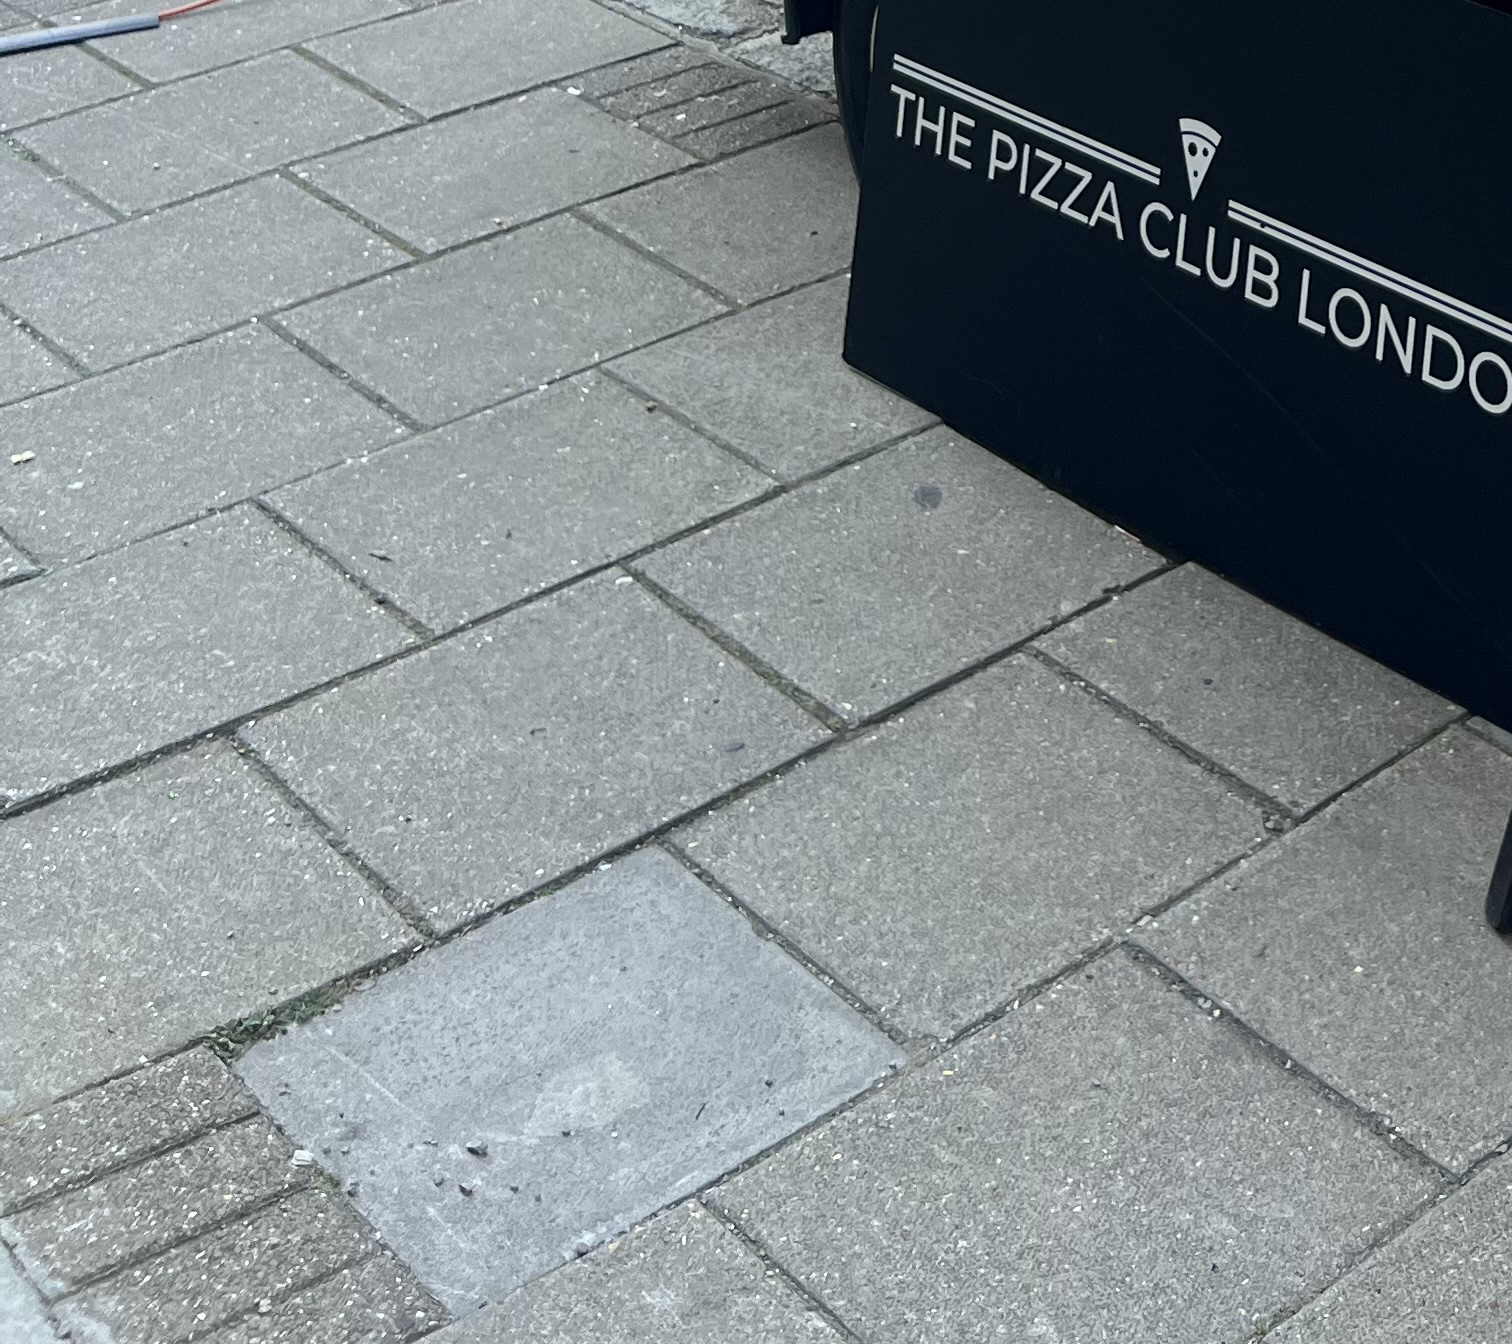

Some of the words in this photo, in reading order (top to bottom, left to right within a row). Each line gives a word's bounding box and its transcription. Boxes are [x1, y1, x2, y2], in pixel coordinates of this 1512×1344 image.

[891, 84, 976, 171] THE
[987, 129, 1125, 241] PIZZA
[1139, 201, 1280, 309] CLUB
